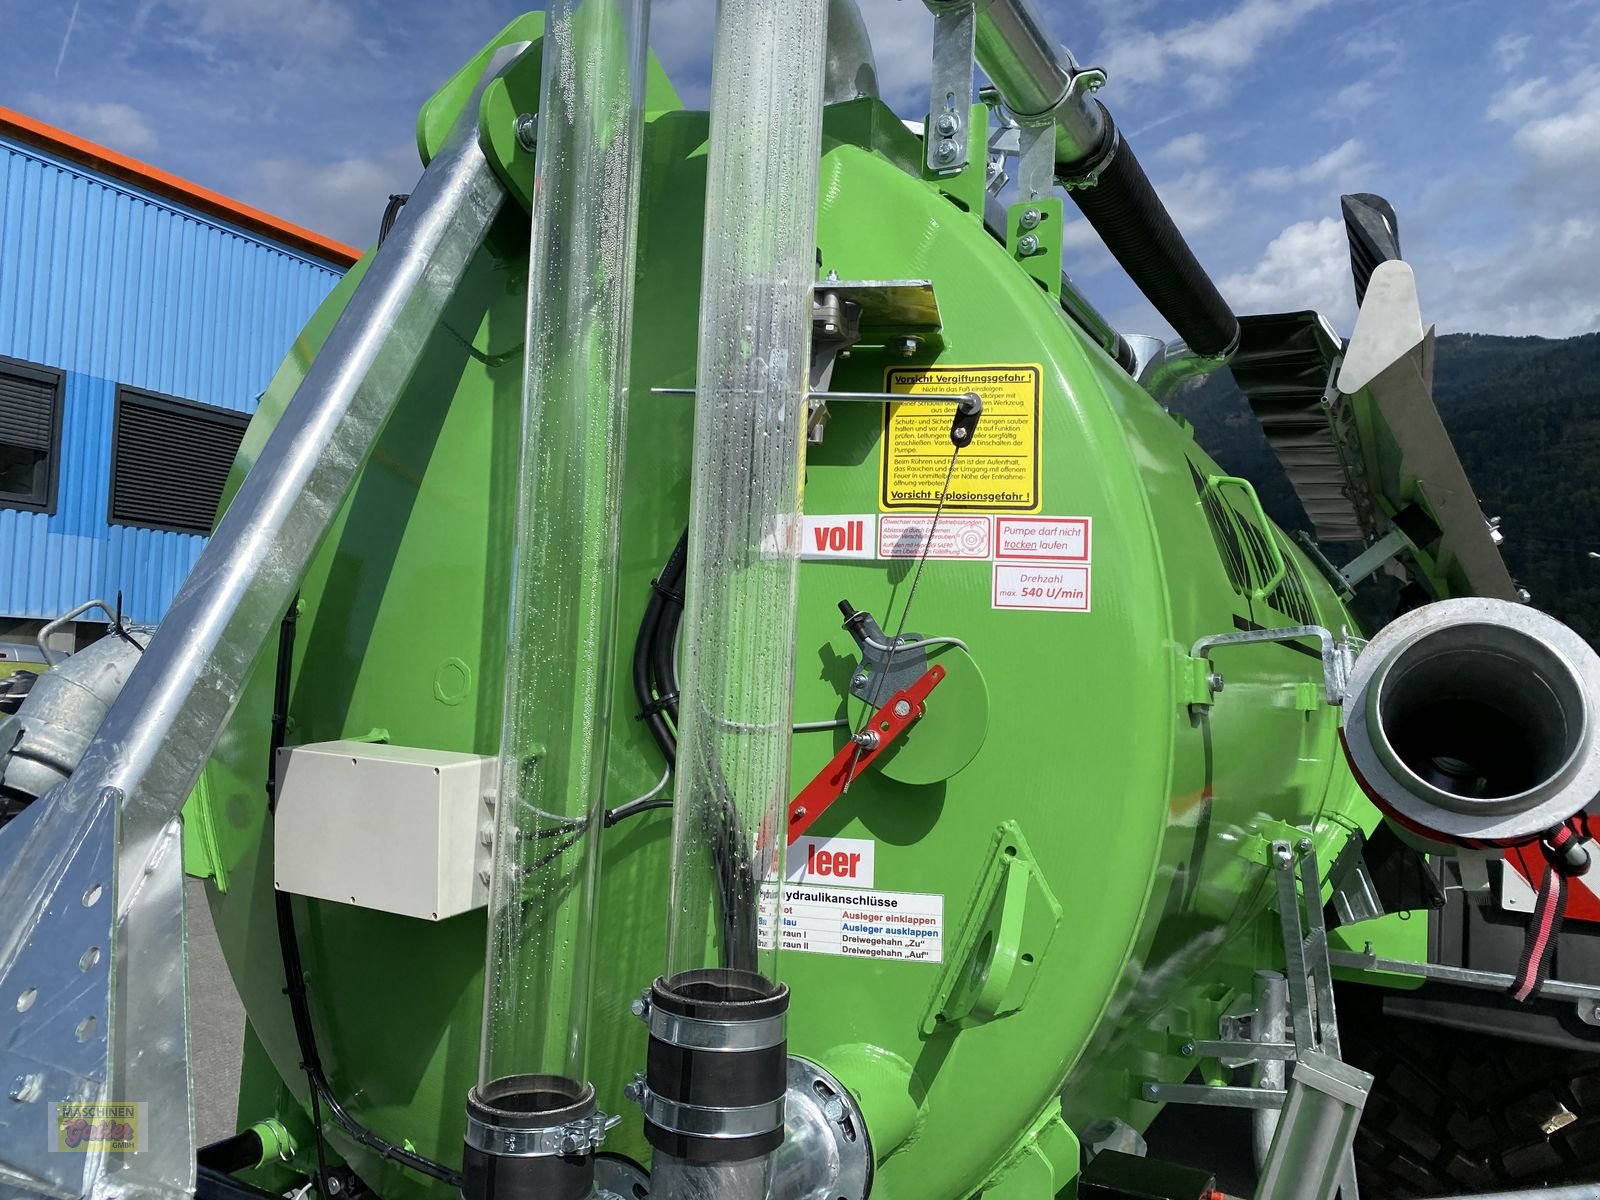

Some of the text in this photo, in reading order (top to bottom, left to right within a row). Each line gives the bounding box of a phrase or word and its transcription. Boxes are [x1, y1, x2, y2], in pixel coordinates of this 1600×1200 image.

[895, 374, 933, 384] Vorsicht
[936, 372, 1025, 385] Vergiftungsgefahr
[994, 400, 1024, 408] Werkzeug
[988, 432, 1017, 441] sorgfältig
[961, 465, 989, 474] Umgang
[891, 490, 932, 499] Vorsicht
[935, 490, 1024, 503] Explosionsgefahr
[814, 520, 864, 552] voll
[1003, 526, 1081, 538] Pumpe darf nicht
[1004, 540, 1068, 550] trocken laufen
[1020, 574, 1063, 584] Drehzahl
[999, 587, 1083, 600] max. 540 U/min
[808, 844, 861, 878] leer
[784, 889, 898, 908] ydraulikanschlüsse
[842, 910, 937, 927] Ausleger einklappen
[842, 922, 939, 939] Ausleger ausklappen
[842, 934, 903, 948] Dreiwegehahn
[842, 945, 903, 958] Dreiwegehahn
